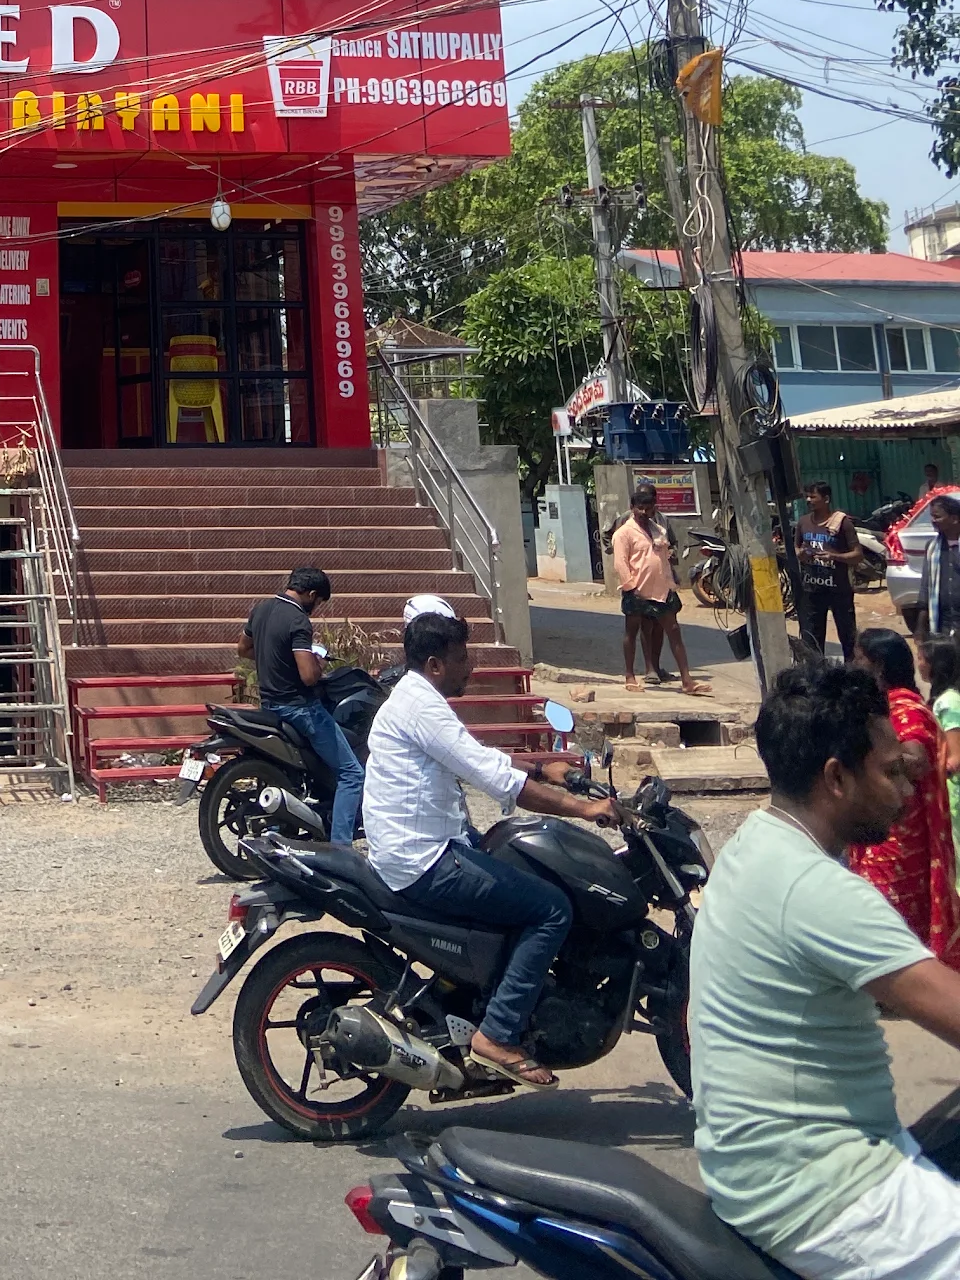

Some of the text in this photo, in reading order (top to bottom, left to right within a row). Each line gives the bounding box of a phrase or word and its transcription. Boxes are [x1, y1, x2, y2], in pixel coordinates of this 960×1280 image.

[386, 31, 503, 61] SATHUPALLY
[284, 80, 317, 95] RBB
[12, 90, 245, 133] BIRYANI
[12, 216, 30, 238] AWAY
[328, 206, 355, 398] 9963968969
[431, 937, 462, 954] YAMAHA
